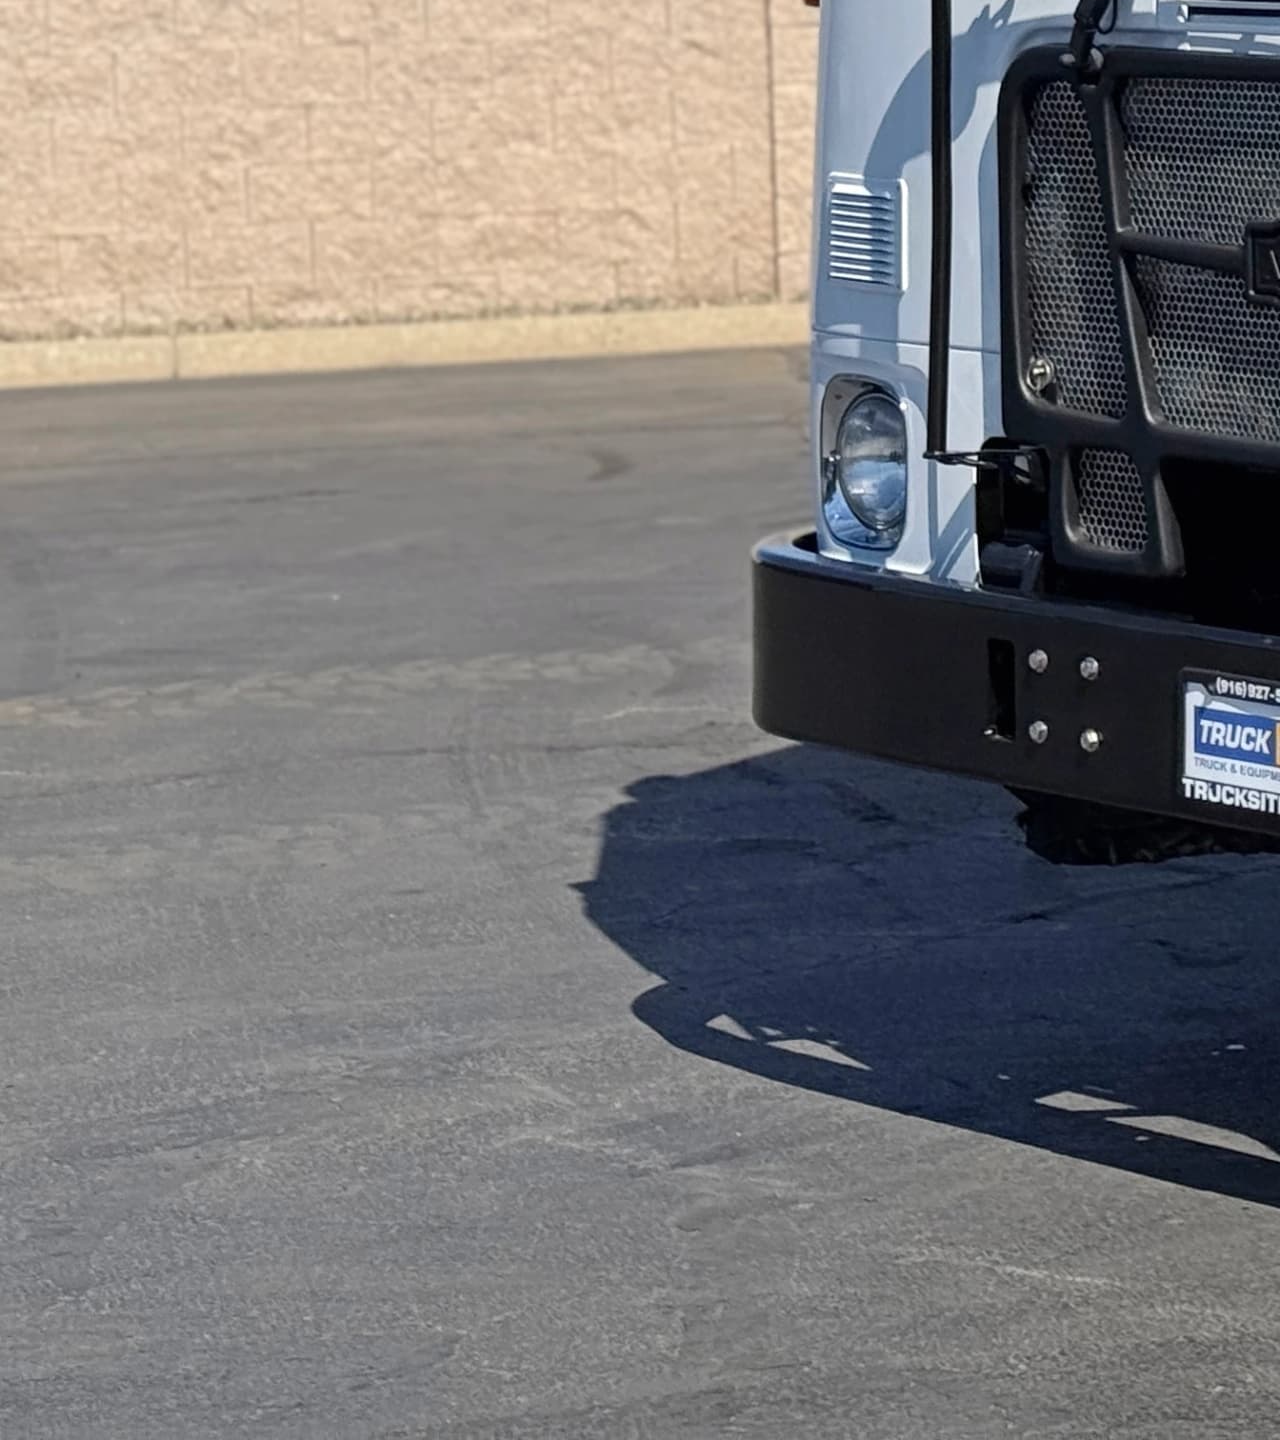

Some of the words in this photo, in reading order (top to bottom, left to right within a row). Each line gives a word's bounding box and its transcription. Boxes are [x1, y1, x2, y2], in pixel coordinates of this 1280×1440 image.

[1200, 719, 1272, 755] TRUCK
[1194, 757, 1228, 773] TRUCK
[1230, 764, 1238, 774] &
